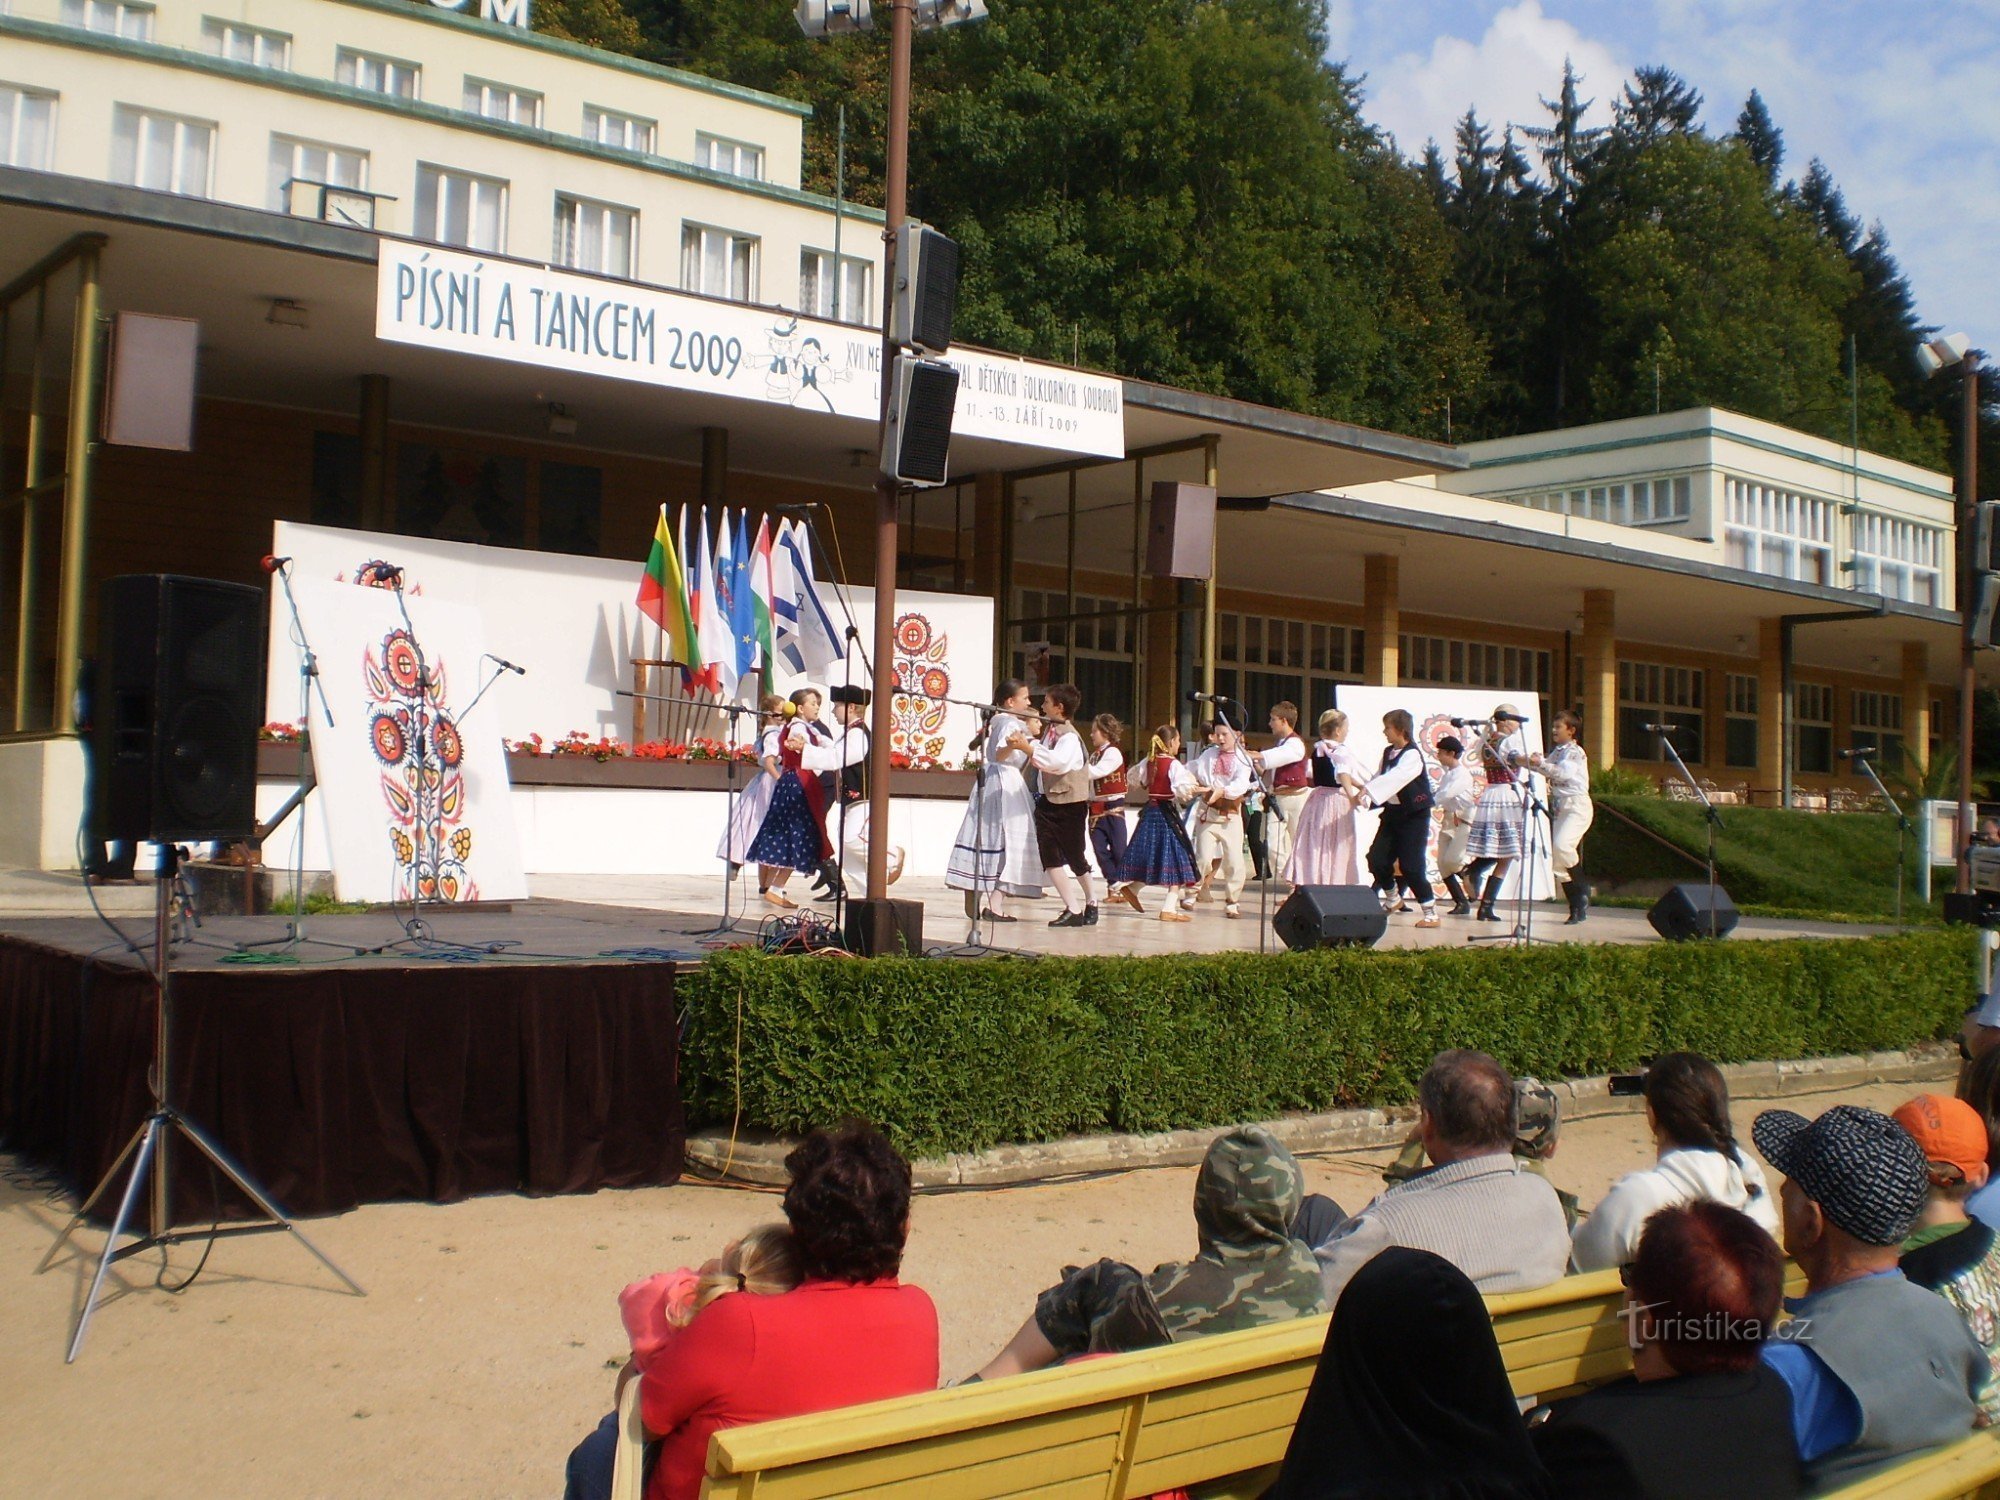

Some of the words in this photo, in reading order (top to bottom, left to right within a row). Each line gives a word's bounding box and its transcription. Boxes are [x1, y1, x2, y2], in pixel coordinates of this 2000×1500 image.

[396, 252, 484, 335] PÍSNÍ
[493, 282, 515, 341] A
[529, 288, 655, 364] TANCEM
[669, 326, 743, 380] 2009
[1016, 405, 1044, 428] ZÁŘÍ
[1049, 416, 1078, 433] 2009
